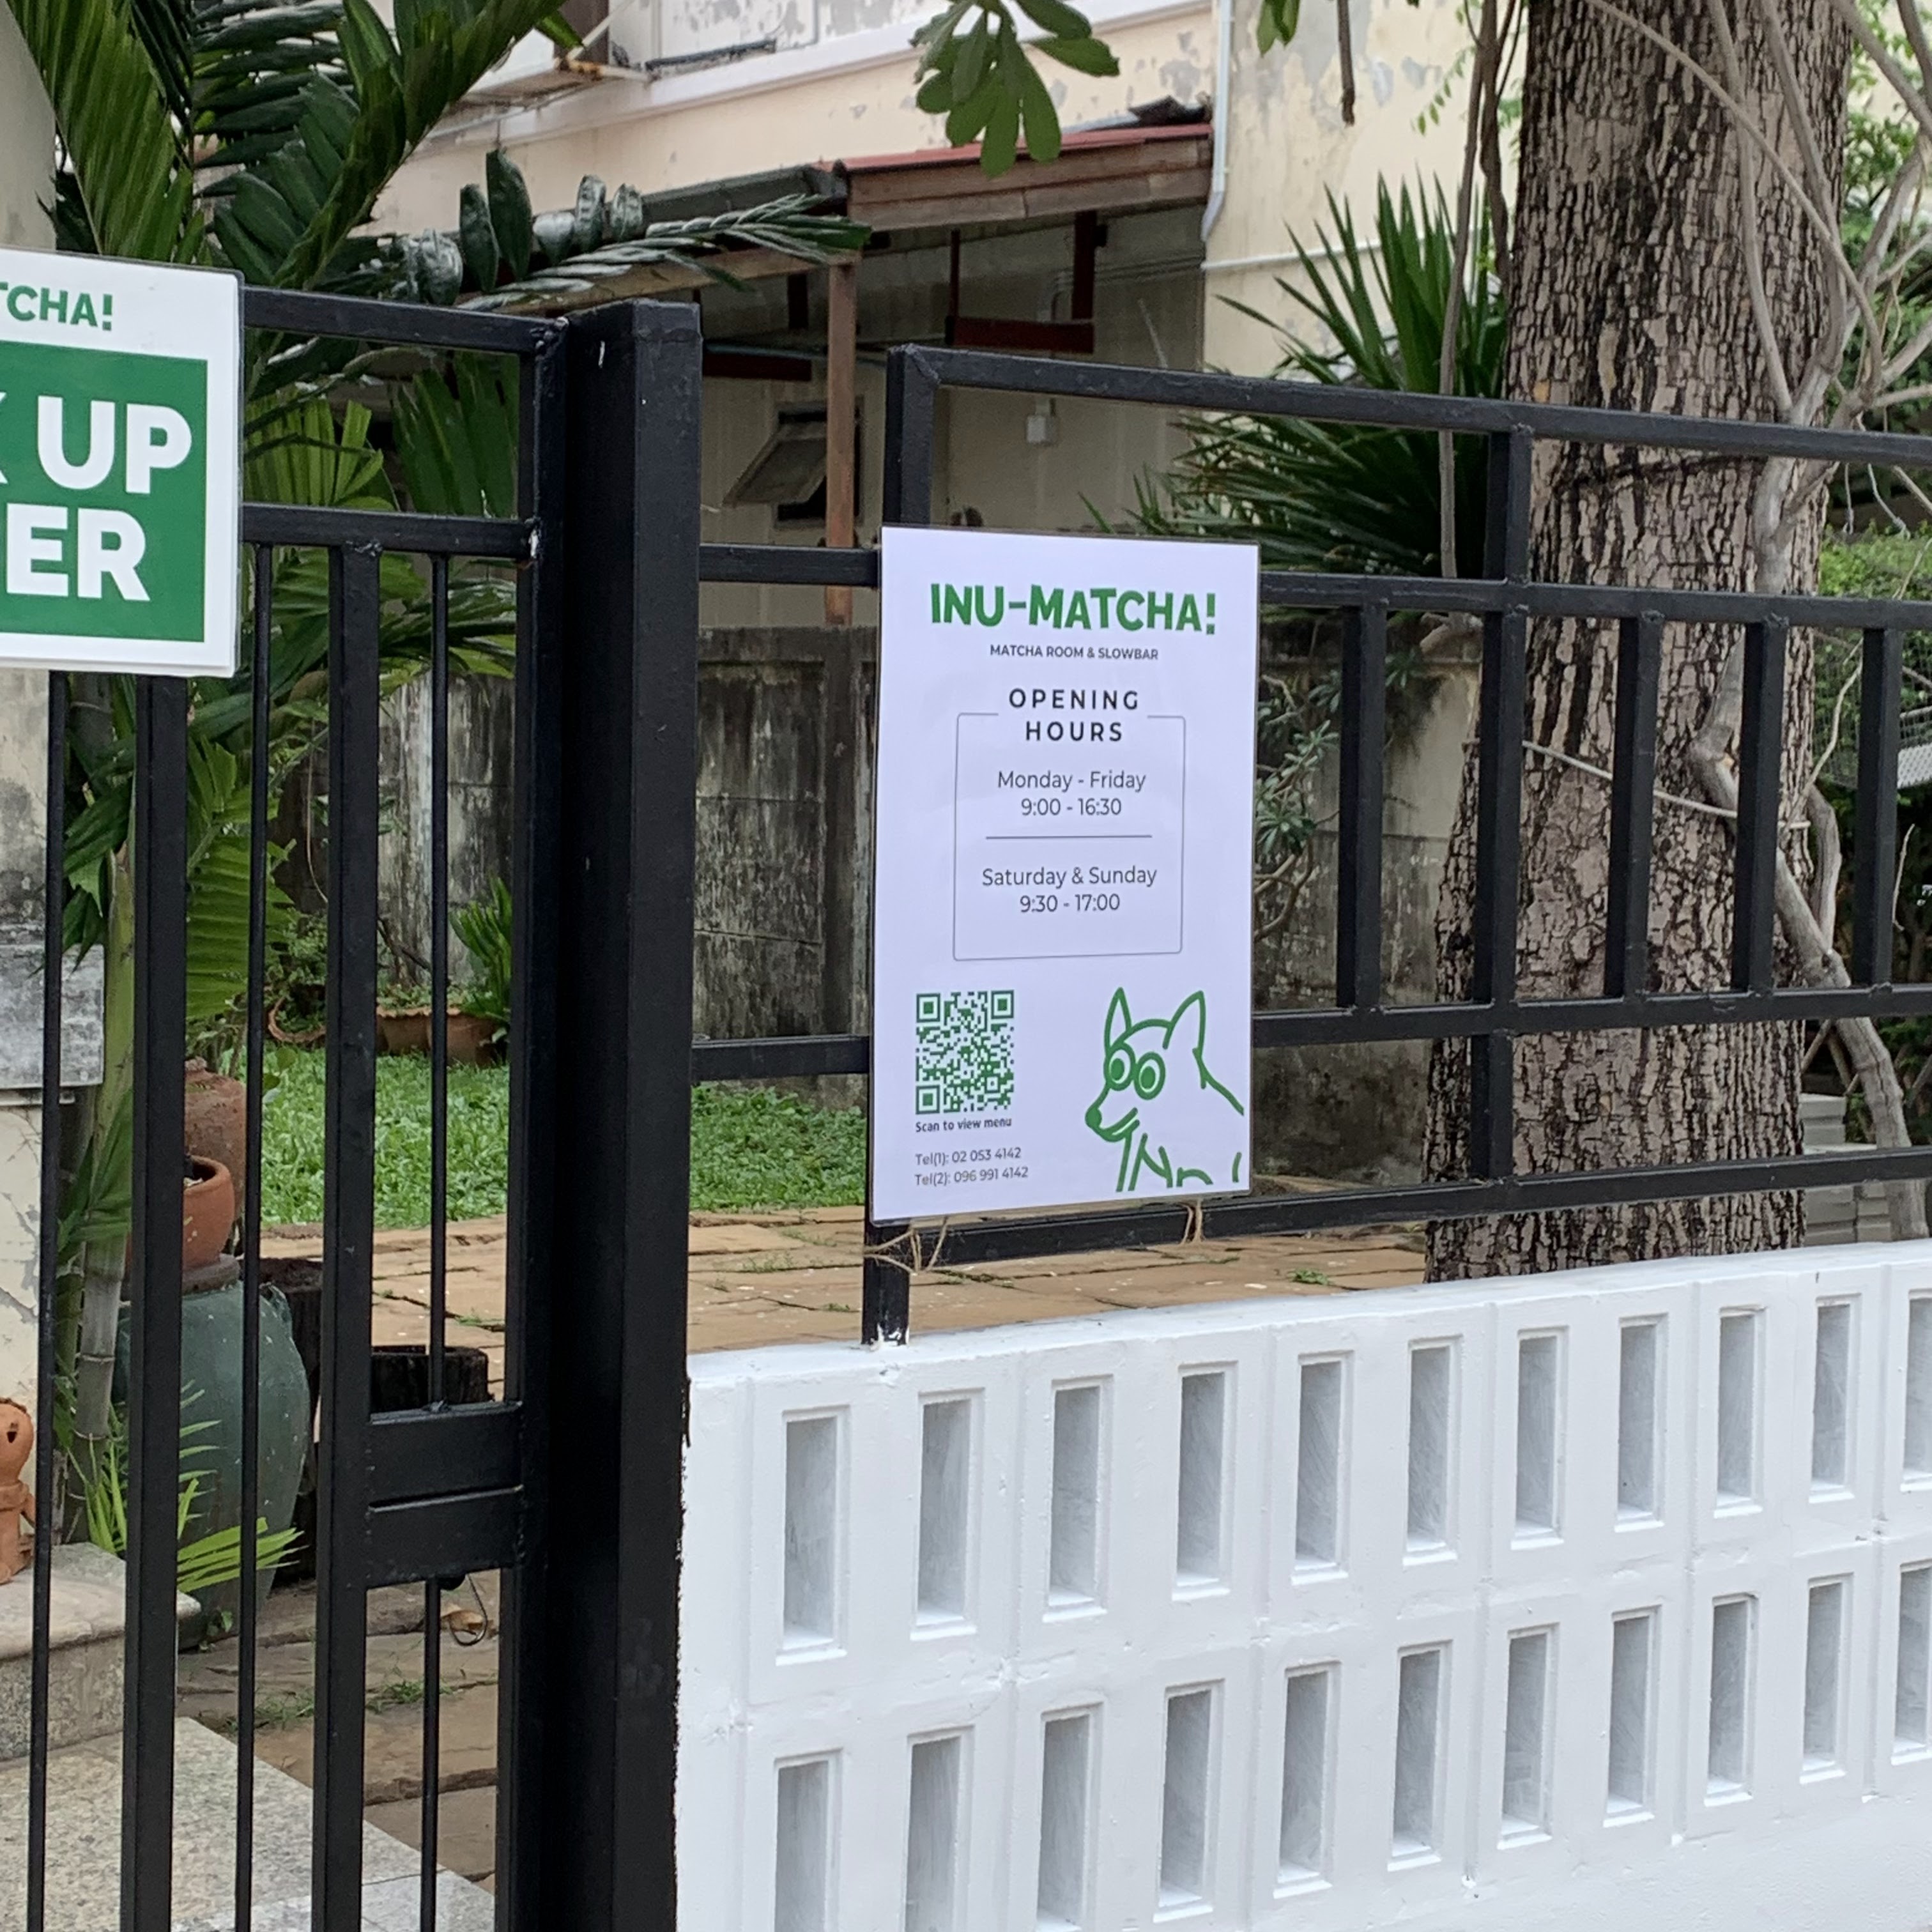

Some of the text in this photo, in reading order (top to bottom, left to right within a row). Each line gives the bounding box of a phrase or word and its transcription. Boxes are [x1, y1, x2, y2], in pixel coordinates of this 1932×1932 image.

[0, 281, 112, 332] CHA!
[37, 394, 192, 494] UP
[6, 502, 151, 602] ER
[930, 583, 1216, 636] INU-MATCHA!
[990, 644, 1158, 660] MATCHA ROOM & SLOWBAR
[1008, 687, 1138, 711] OPENING
[1025, 720, 1123, 742] HOURS
[997, 770, 1073, 793] Monday
[1089, 769, 1147, 793] Friday
[1021, 797, 1061, 816] 9:00
[1077, 797, 1123, 816] 16:30
[982, 864, 1158, 890] Saturday & Sunday
[1020, 894, 1058, 914] 9:30
[1074, 893, 1121, 912] 17:00
[915, 1117, 1012, 1133] Scan to view menu
[951, 1151, 967, 1163] 02
[969, 1148, 992, 1162] 053
[994, 1147, 1022, 1160] 4142
[954, 1169, 977, 1183] 096
[979, 1168, 999, 1182] 991
[1001, 1166, 1029, 1179] 4142
